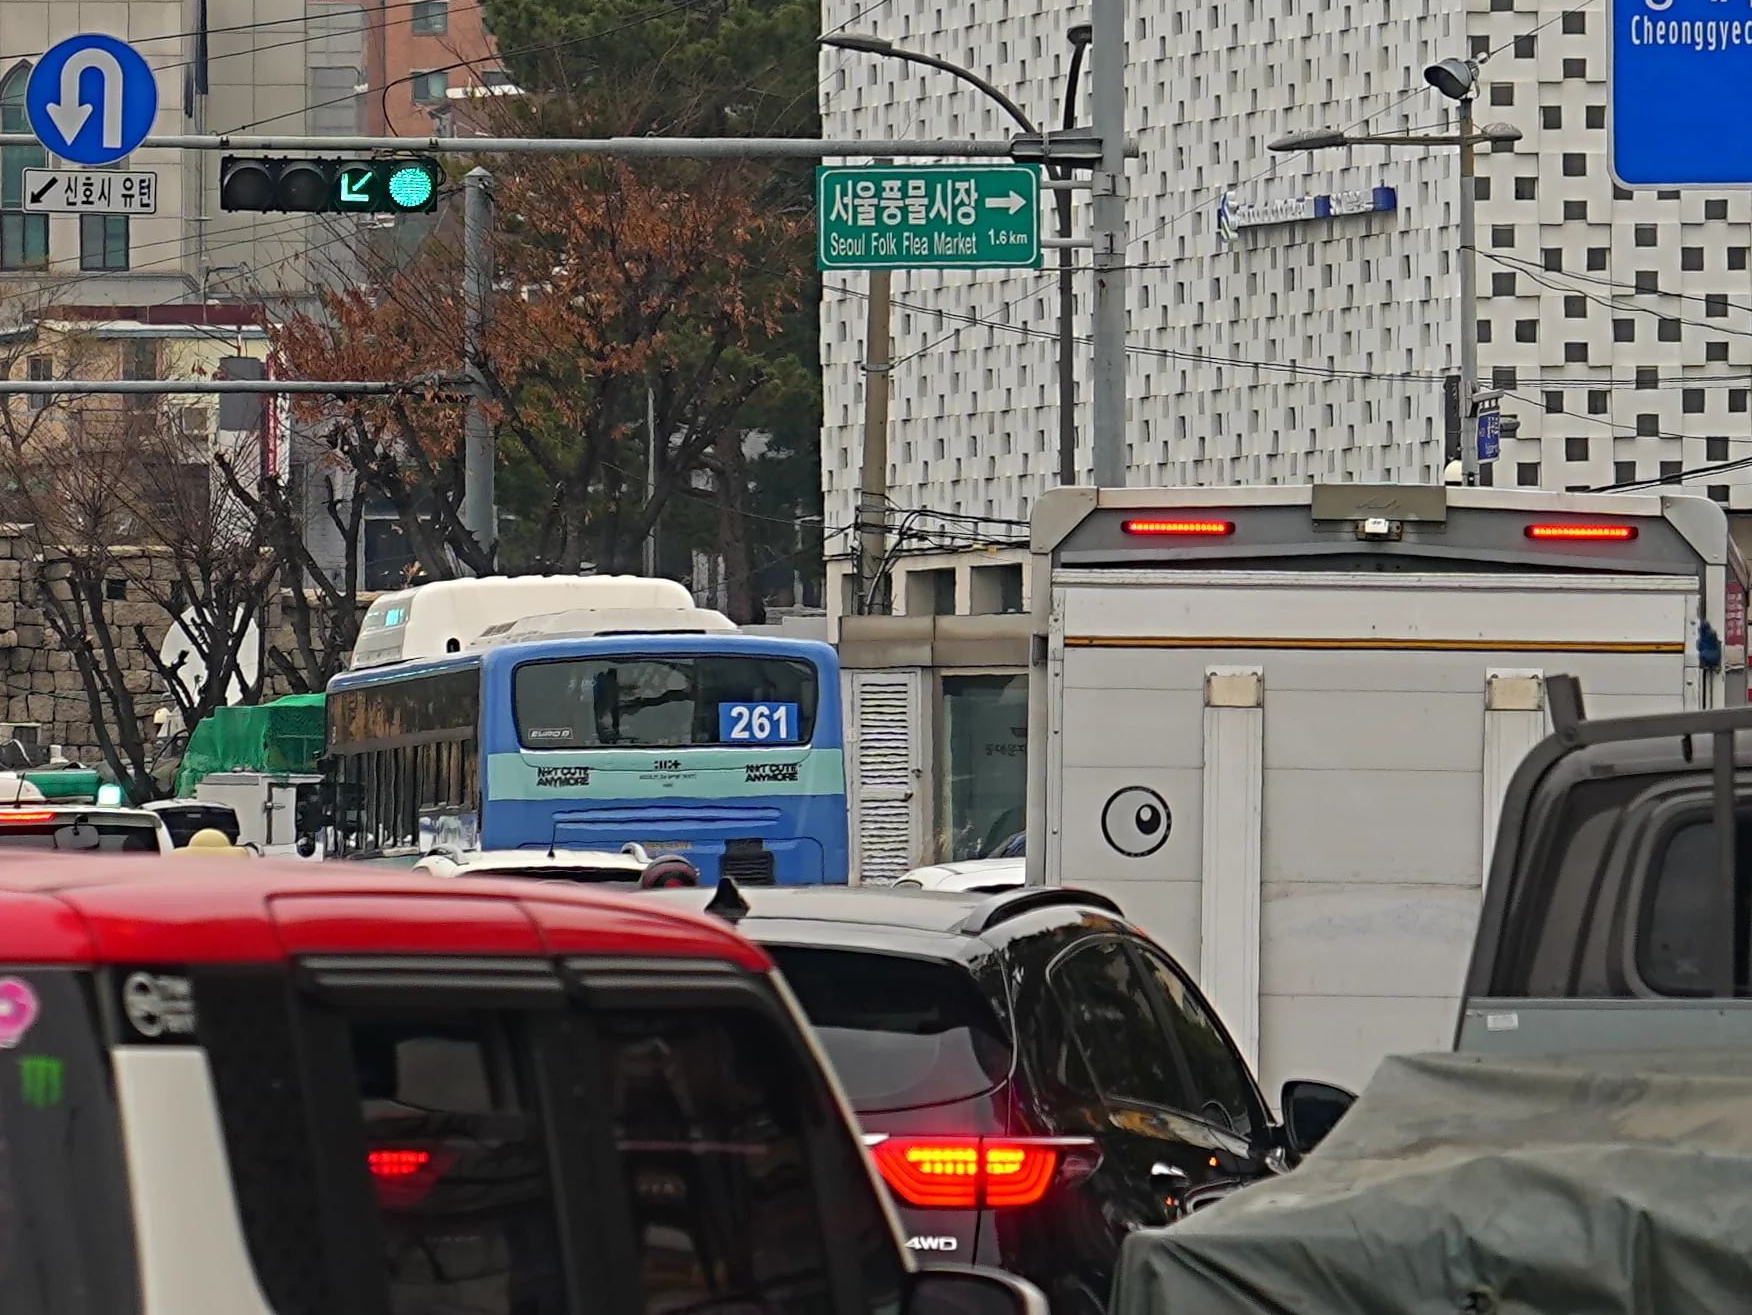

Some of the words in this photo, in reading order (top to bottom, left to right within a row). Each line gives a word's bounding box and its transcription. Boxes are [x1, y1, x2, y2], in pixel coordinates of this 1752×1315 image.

[65, 175, 112, 208] 신호시
[121, 177, 152, 208] 유턴
[830, 178, 979, 226] 서울풍물시장
[830, 233, 866, 257] Seoul
[871, 233, 898, 256] Folk
[902, 233, 928, 256] Flea
[932, 234, 977, 257] Market
[729, 705, 788, 739] 261
[744, 772, 799, 783] ANYMORE
[905, 1236, 958, 1252] 4WD
